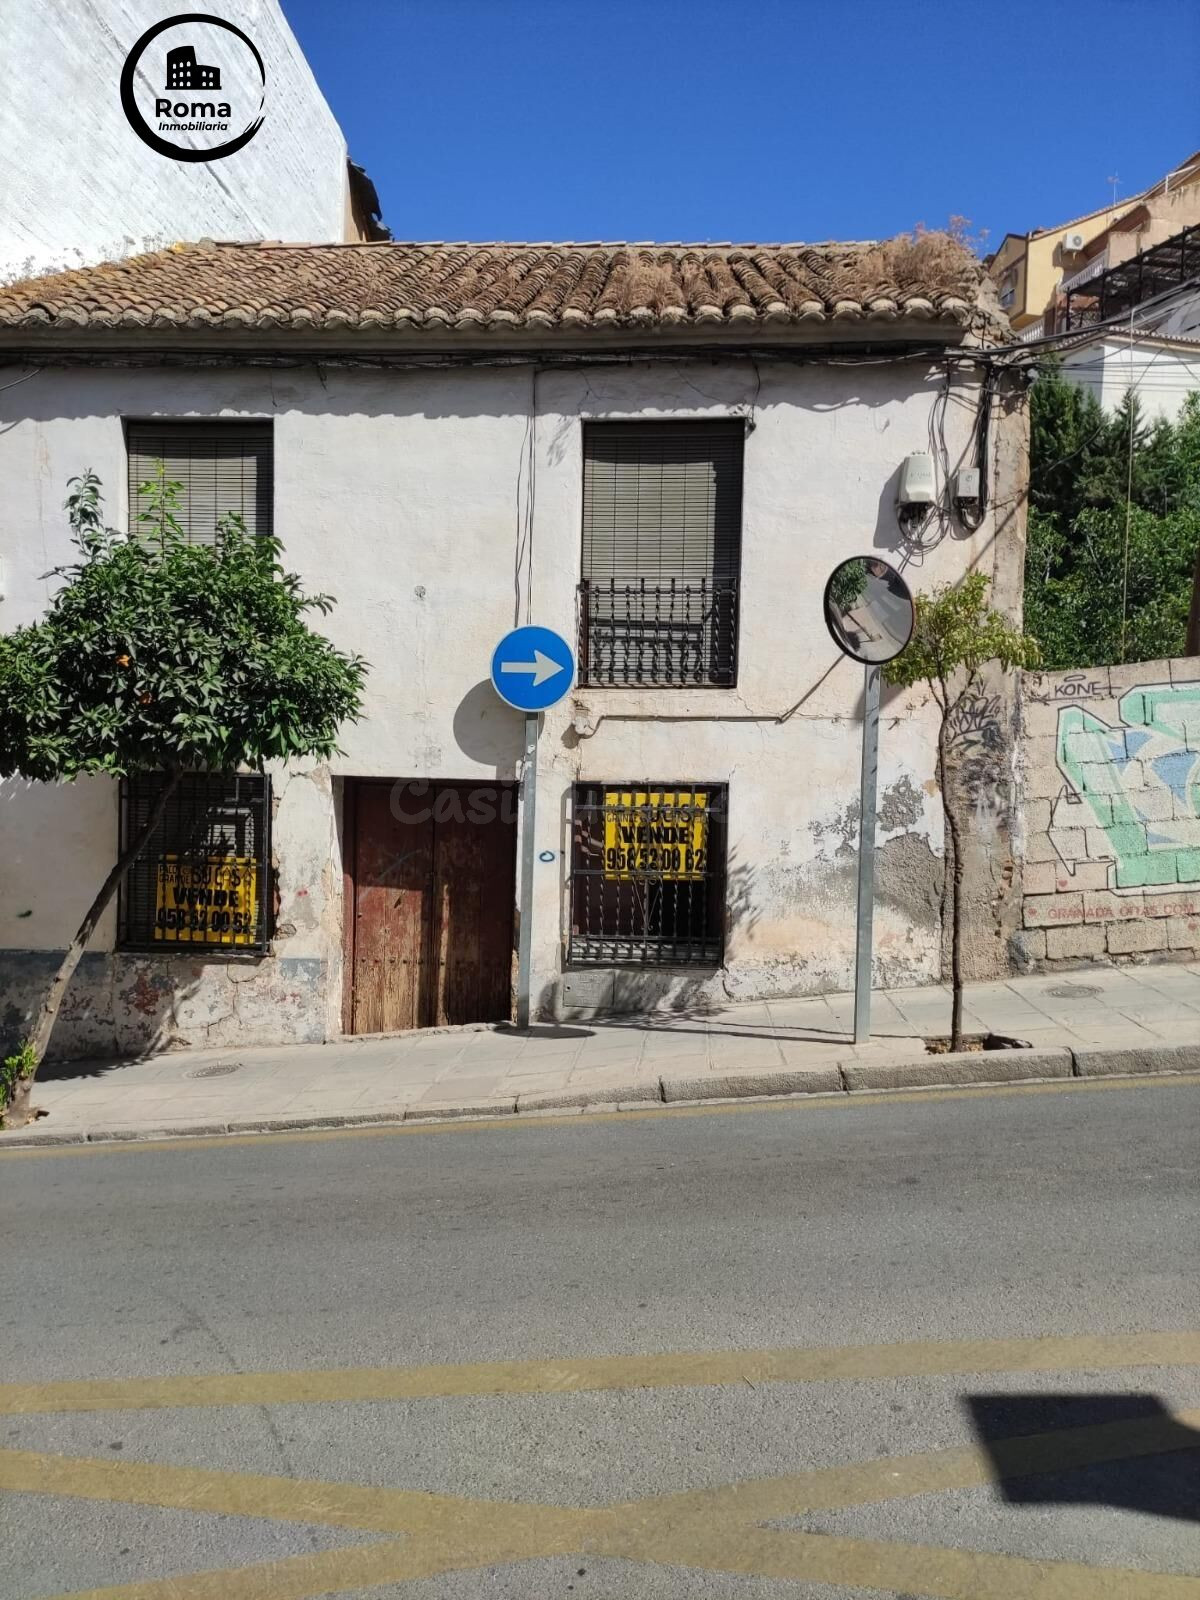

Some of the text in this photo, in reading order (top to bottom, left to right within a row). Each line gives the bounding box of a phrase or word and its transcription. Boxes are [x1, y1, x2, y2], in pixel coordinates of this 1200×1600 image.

[1054, 681, 1120, 698] KONE
[621, 826, 690, 844] VENDE
[173, 887, 239, 908] VENDE
